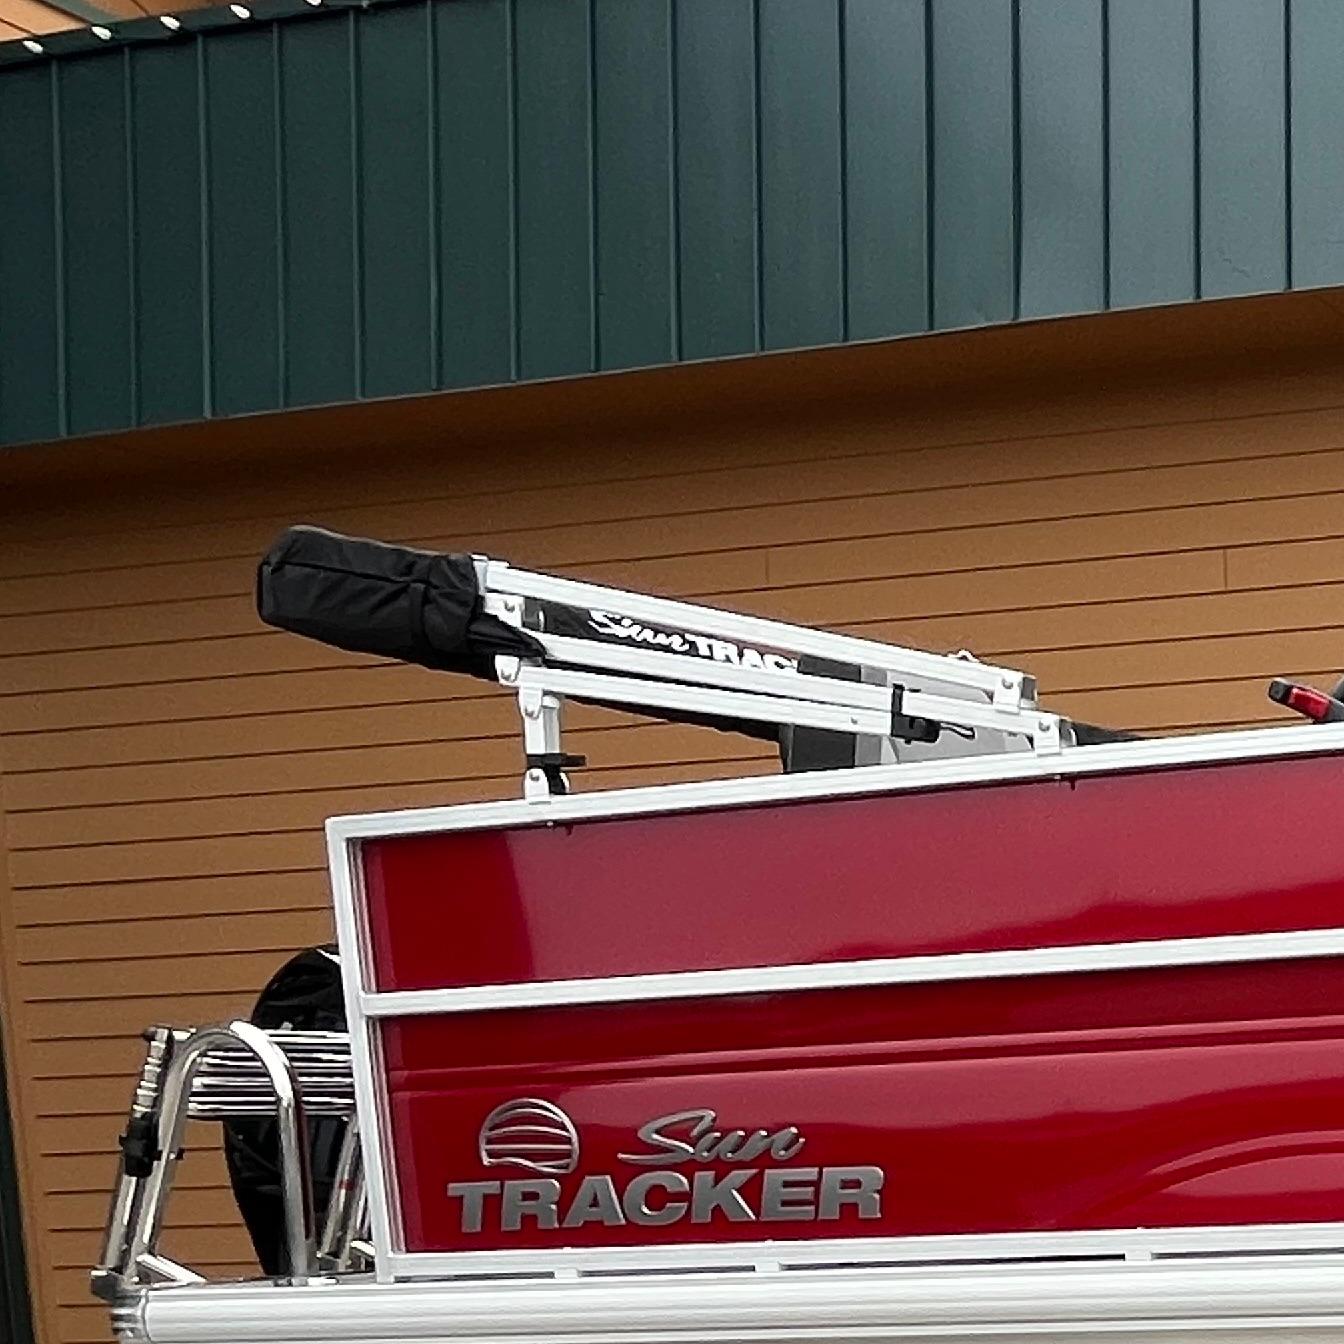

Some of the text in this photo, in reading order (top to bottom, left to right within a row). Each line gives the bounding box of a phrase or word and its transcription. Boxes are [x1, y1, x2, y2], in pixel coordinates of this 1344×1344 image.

[684, 633, 799, 671] TRAC
[617, 1108, 806, 1165] Sun
[447, 1165, 885, 1233] TRACKER
